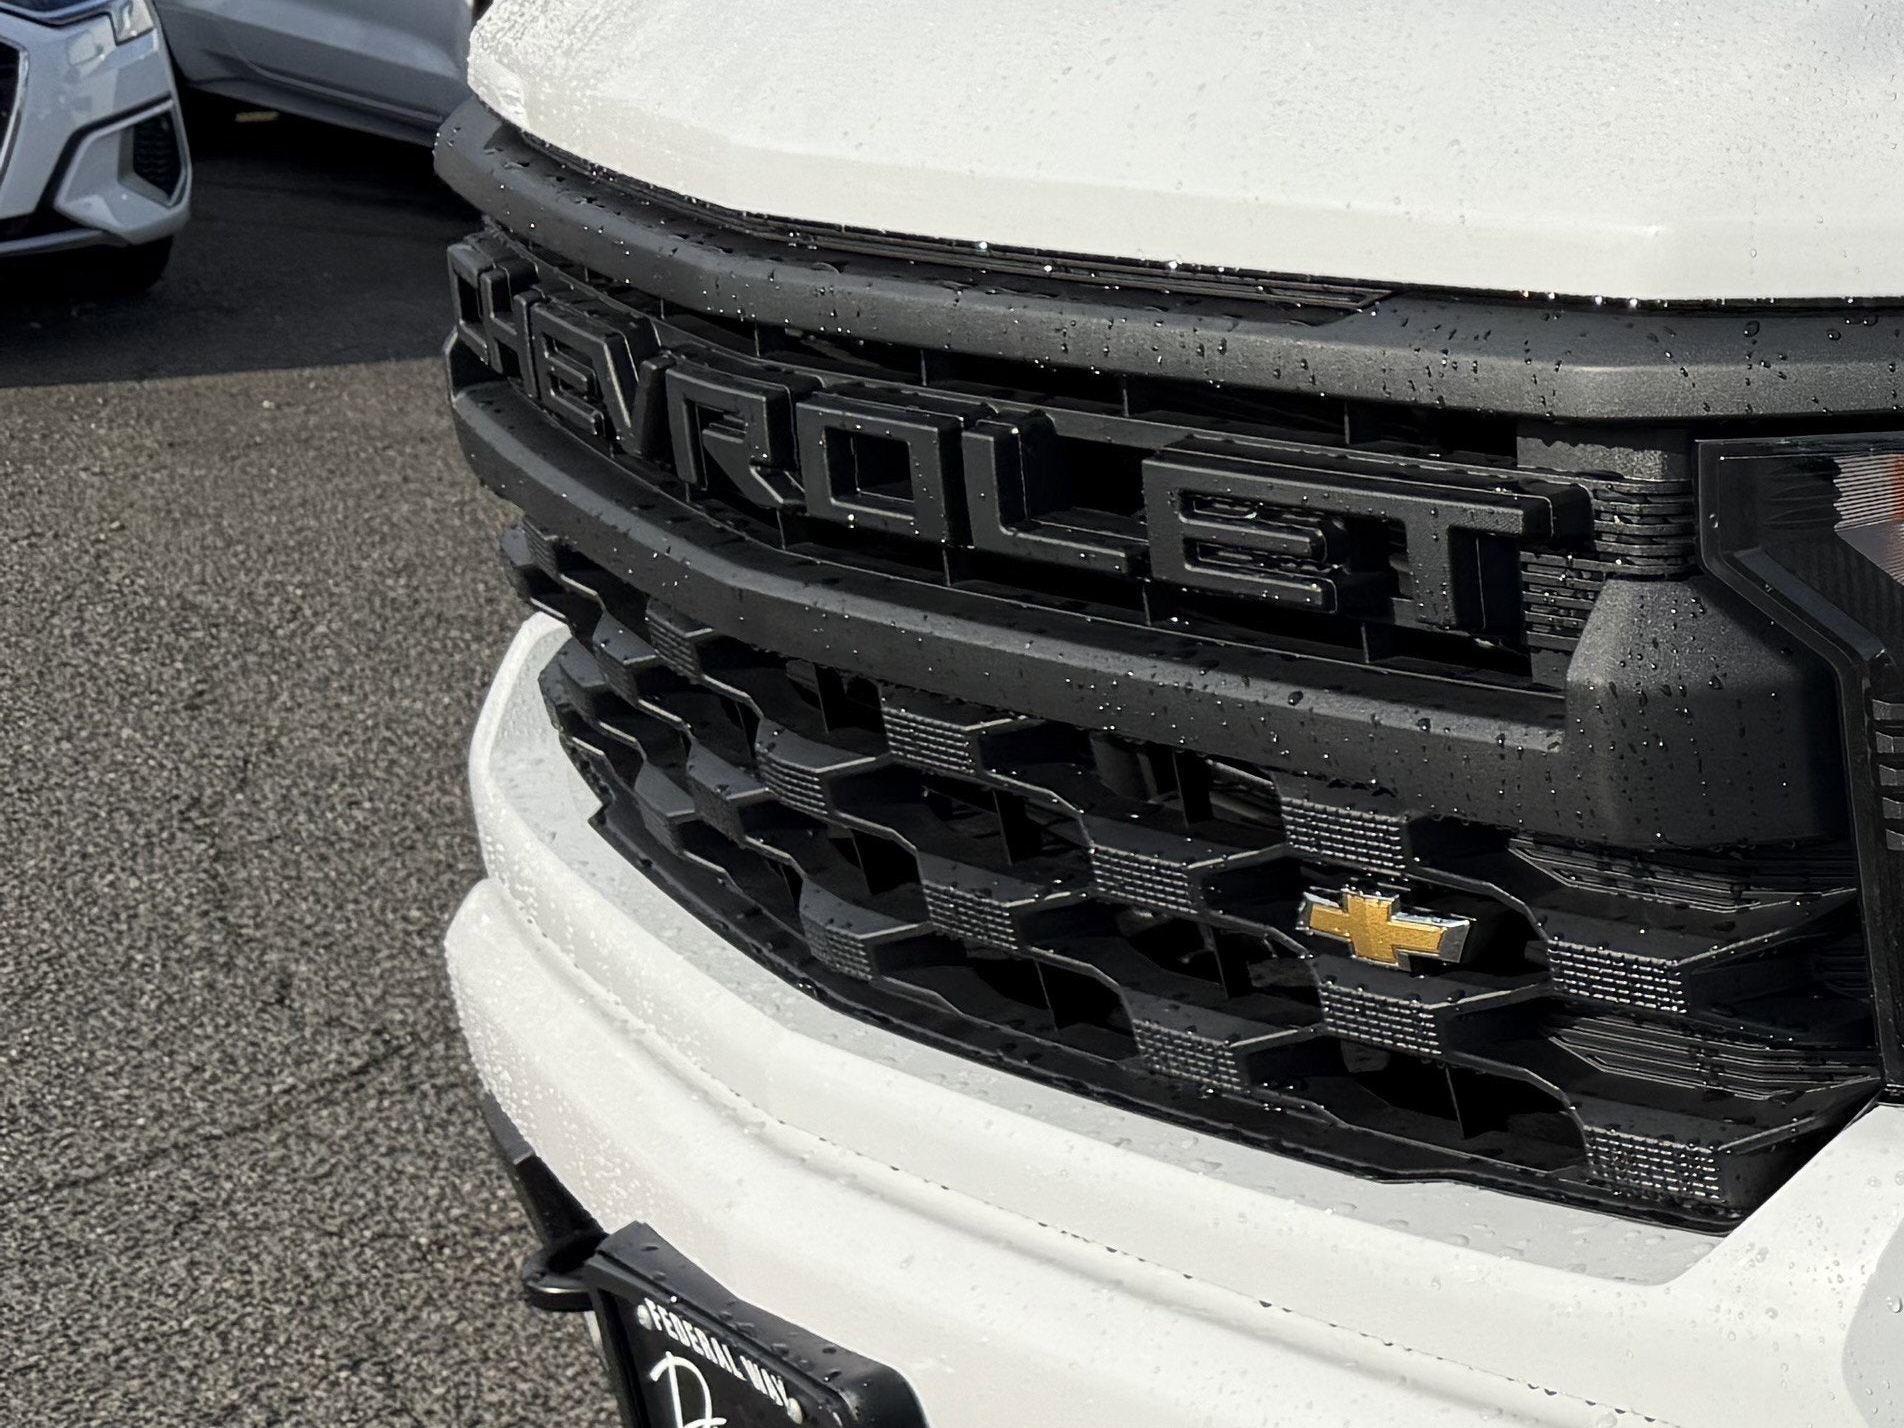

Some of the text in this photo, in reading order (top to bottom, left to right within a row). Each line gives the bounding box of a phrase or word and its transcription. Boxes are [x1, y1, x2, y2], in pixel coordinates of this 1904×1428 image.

[447, 237, 1592, 638] CHEVROLET
[644, 1297, 791, 1409] FEDERAL WAY
